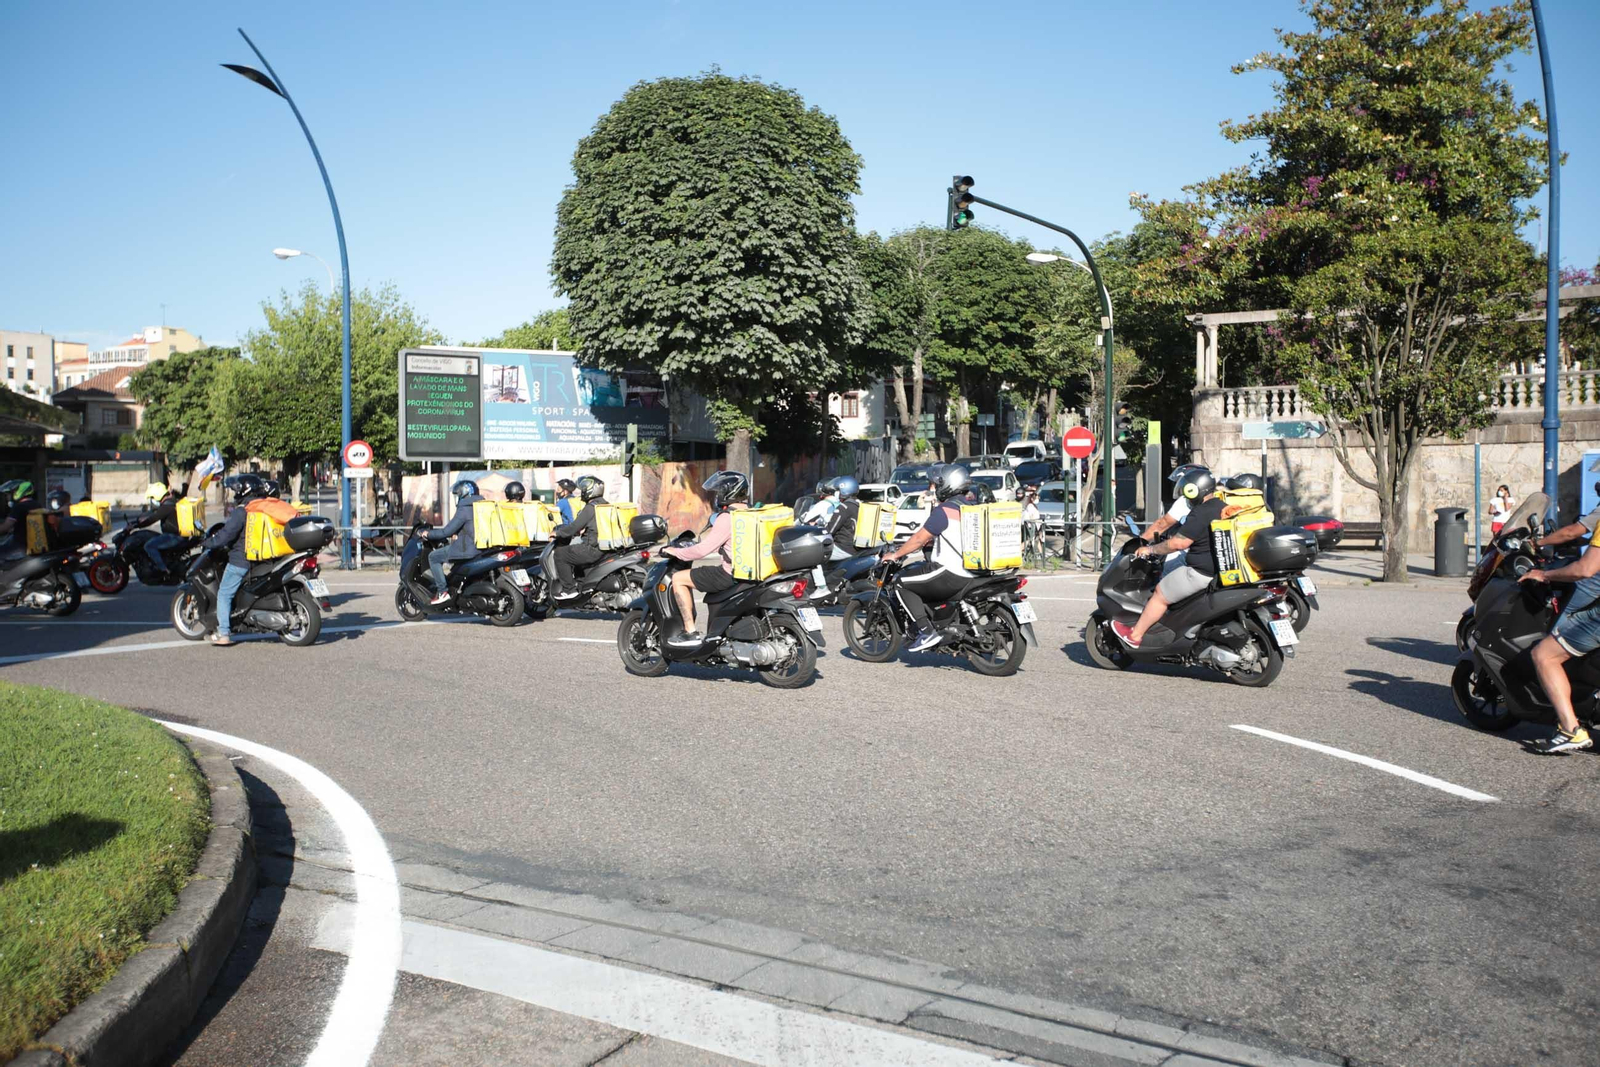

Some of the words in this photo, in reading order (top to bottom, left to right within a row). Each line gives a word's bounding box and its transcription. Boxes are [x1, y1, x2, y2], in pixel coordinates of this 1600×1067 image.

[417, 408, 465, 416] CORONAVIRUS
[532, 406, 565, 416] SPORT
[572, 407, 590, 416] SPA
[735, 518, 746, 565] Glovo
